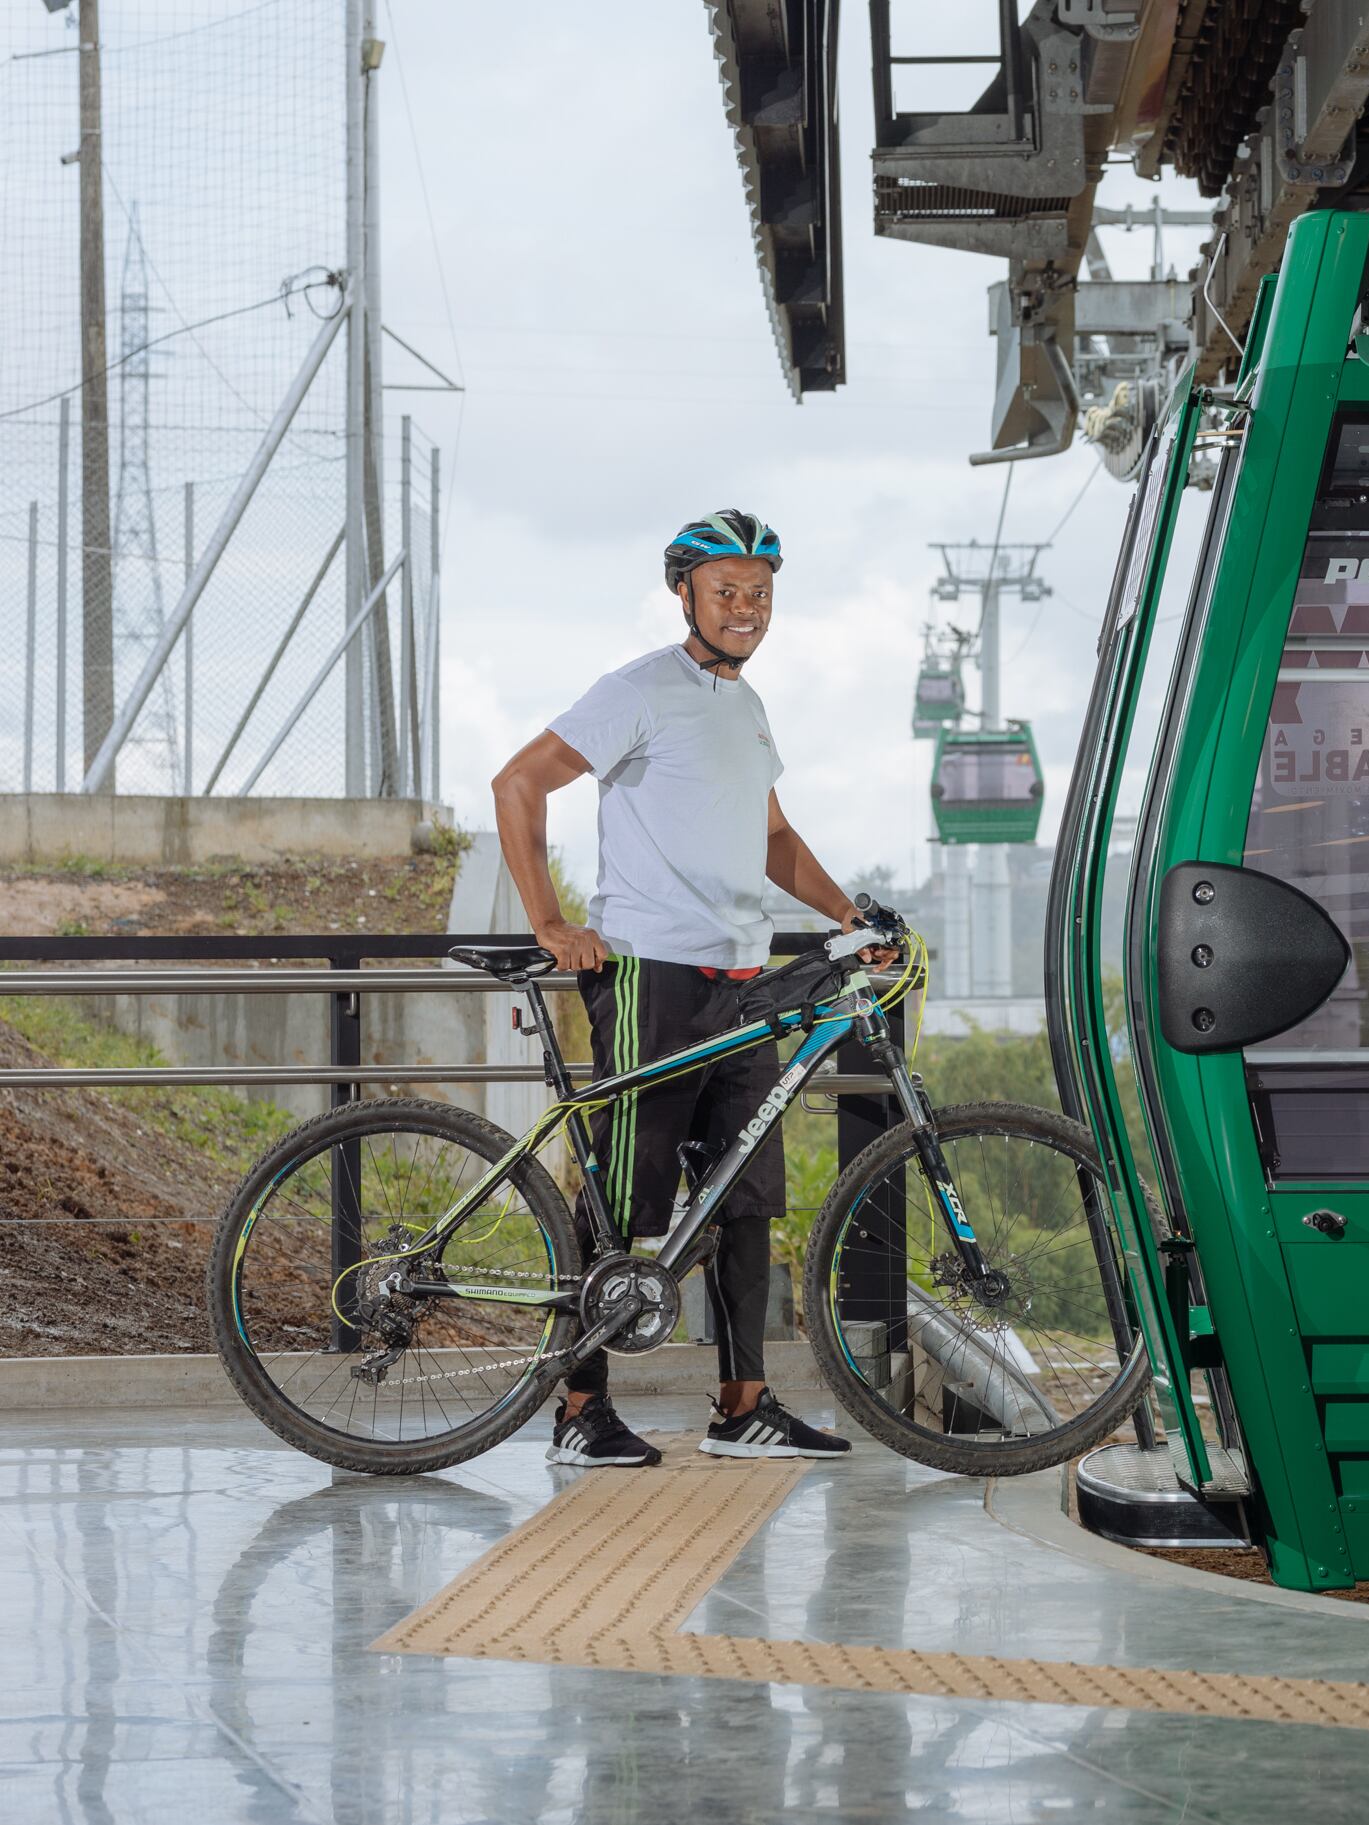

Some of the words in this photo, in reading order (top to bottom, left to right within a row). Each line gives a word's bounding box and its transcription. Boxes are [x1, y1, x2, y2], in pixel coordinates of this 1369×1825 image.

[737, 1085, 789, 1154] Jeep
[942, 1181, 968, 1225] XCR
[465, 1287, 504, 1297] SHIMANO
